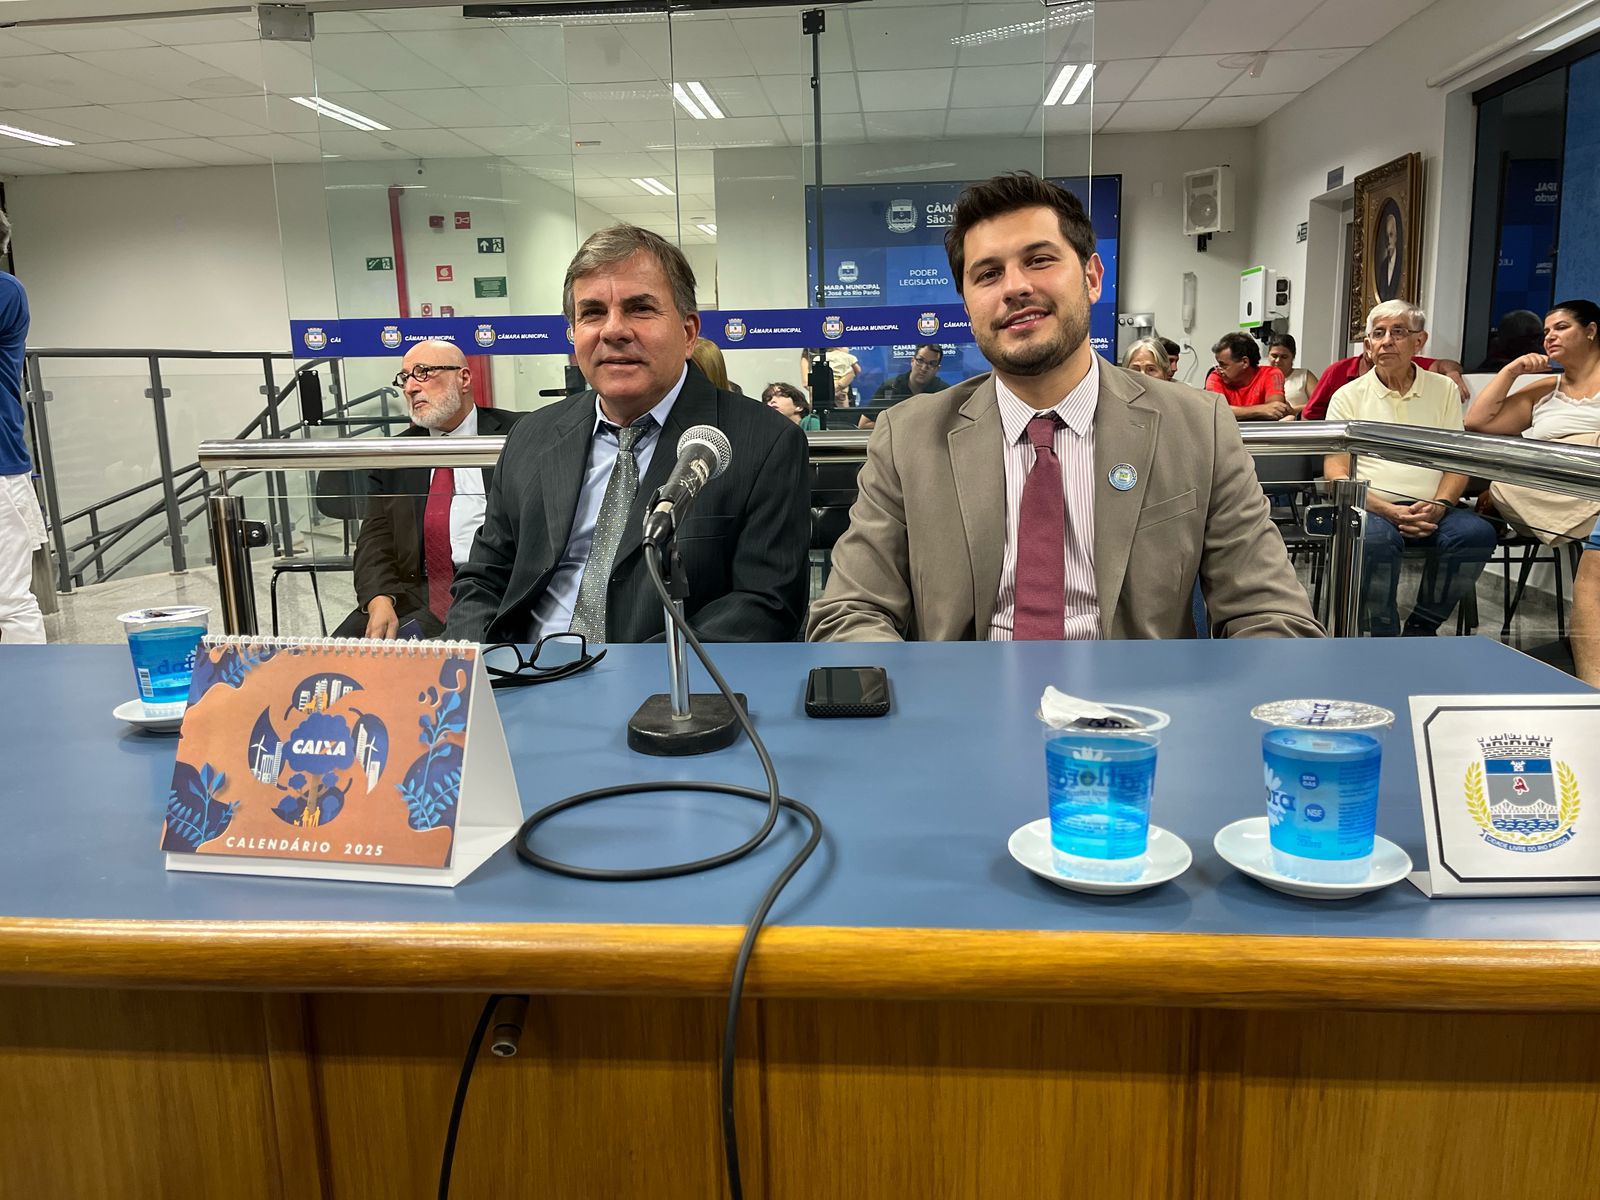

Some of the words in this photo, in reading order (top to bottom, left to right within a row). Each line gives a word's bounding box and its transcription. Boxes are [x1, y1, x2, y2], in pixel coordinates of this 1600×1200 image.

[926, 214, 946, 224] São
[910, 269, 938, 277] PODER
[899, 278, 949, 286] LEGISLATIVO
[292, 739, 347, 756] CAIXA
[225, 836, 331, 853] CALENDÁRIO
[344, 843, 384, 857] 2025
[1486, 836, 1508, 849] CIDADE
[1509, 844, 1526, 852] LIVRE
[1537, 843, 1549, 851] RIO
[1548, 837, 1569, 849] PARDO
